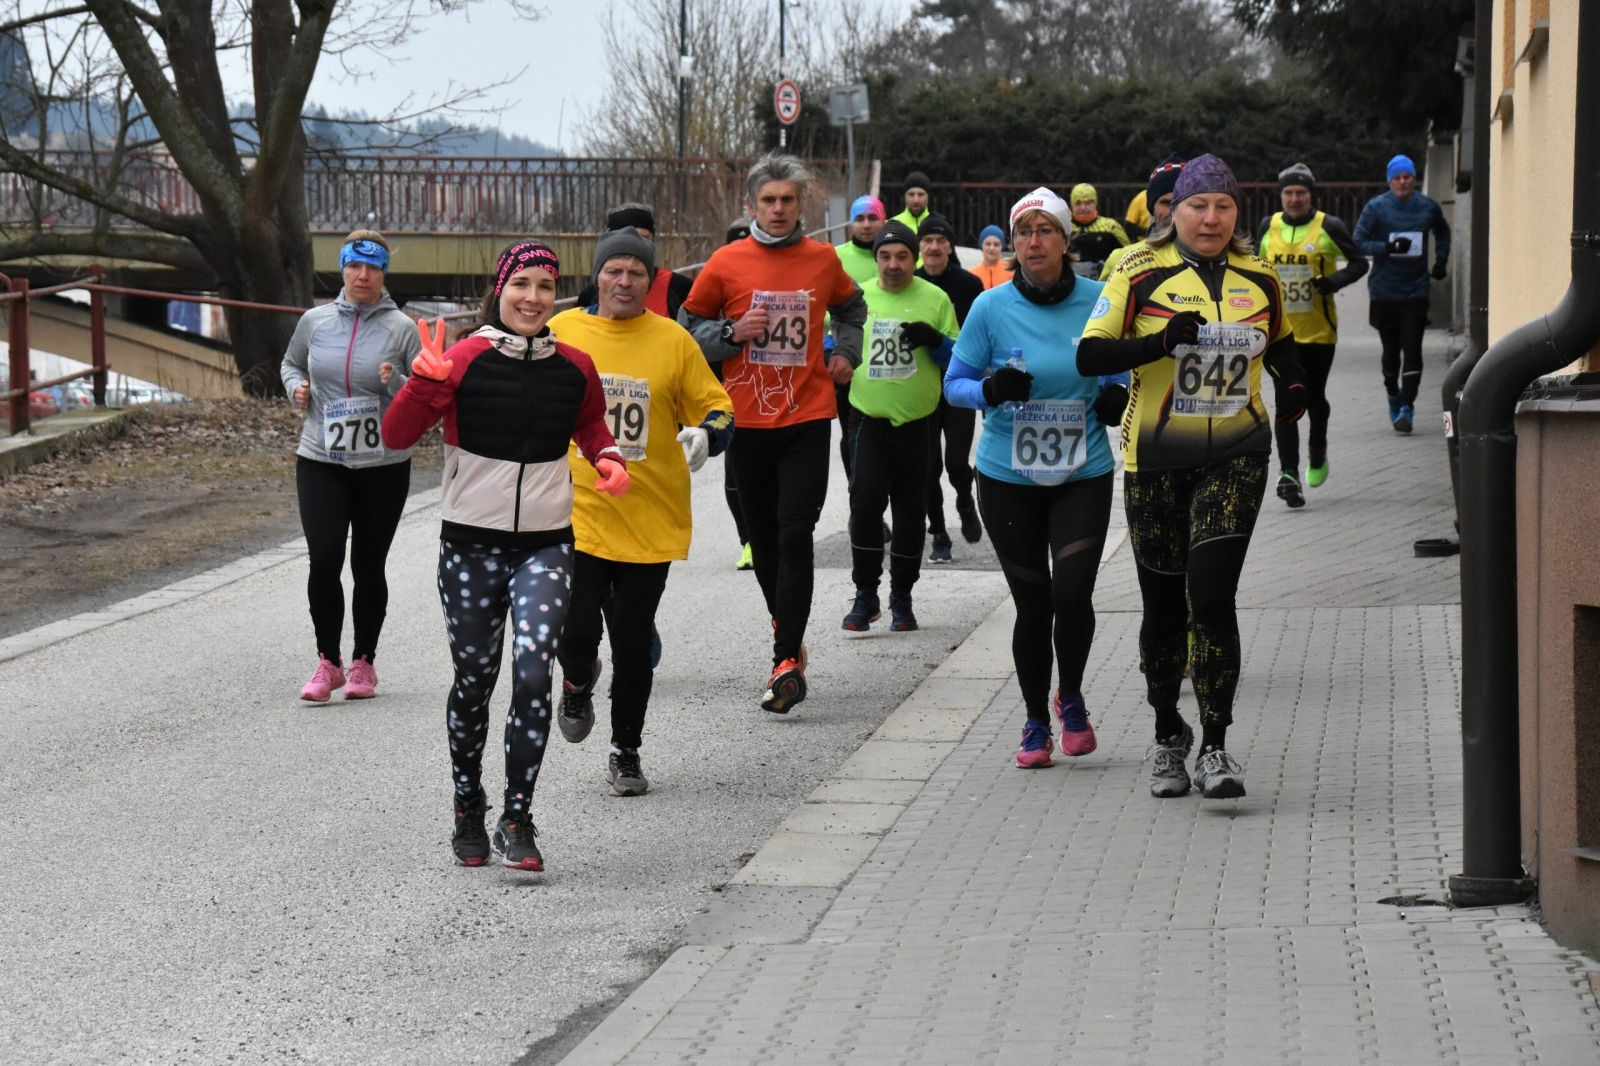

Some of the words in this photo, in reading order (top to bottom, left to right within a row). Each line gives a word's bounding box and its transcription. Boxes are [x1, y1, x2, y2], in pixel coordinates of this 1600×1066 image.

[1117, 249, 1155, 274] SPINNING
[1126, 257, 1155, 271] KLUB
[1274, 253, 1308, 265] KRB
[495, 255, 515, 297] SWEEP
[754, 293, 777, 303] ZIMNÍ
[752, 303, 787, 311] BECKÁ
[1198, 336, 1224, 346] ECKÁ
[1229, 338, 1250, 347] LIGA
[869, 338, 914, 366] 285
[1178, 352, 1249, 397] 642
[603, 388, 626, 397] ECKÁ
[629, 389, 649, 399] LIGA
[326, 400, 347, 411] ZIMNÍ
[326, 408, 358, 419] BĚŽECKÁ
[361, 406, 378, 414] LIGA
[1015, 412, 1057, 422] BĚŽECKÁ
[1061, 414, 1083, 422] LIGA
[608, 402, 645, 442] 19
[328, 417, 380, 451] 278
[1016, 426, 1084, 467] 637
